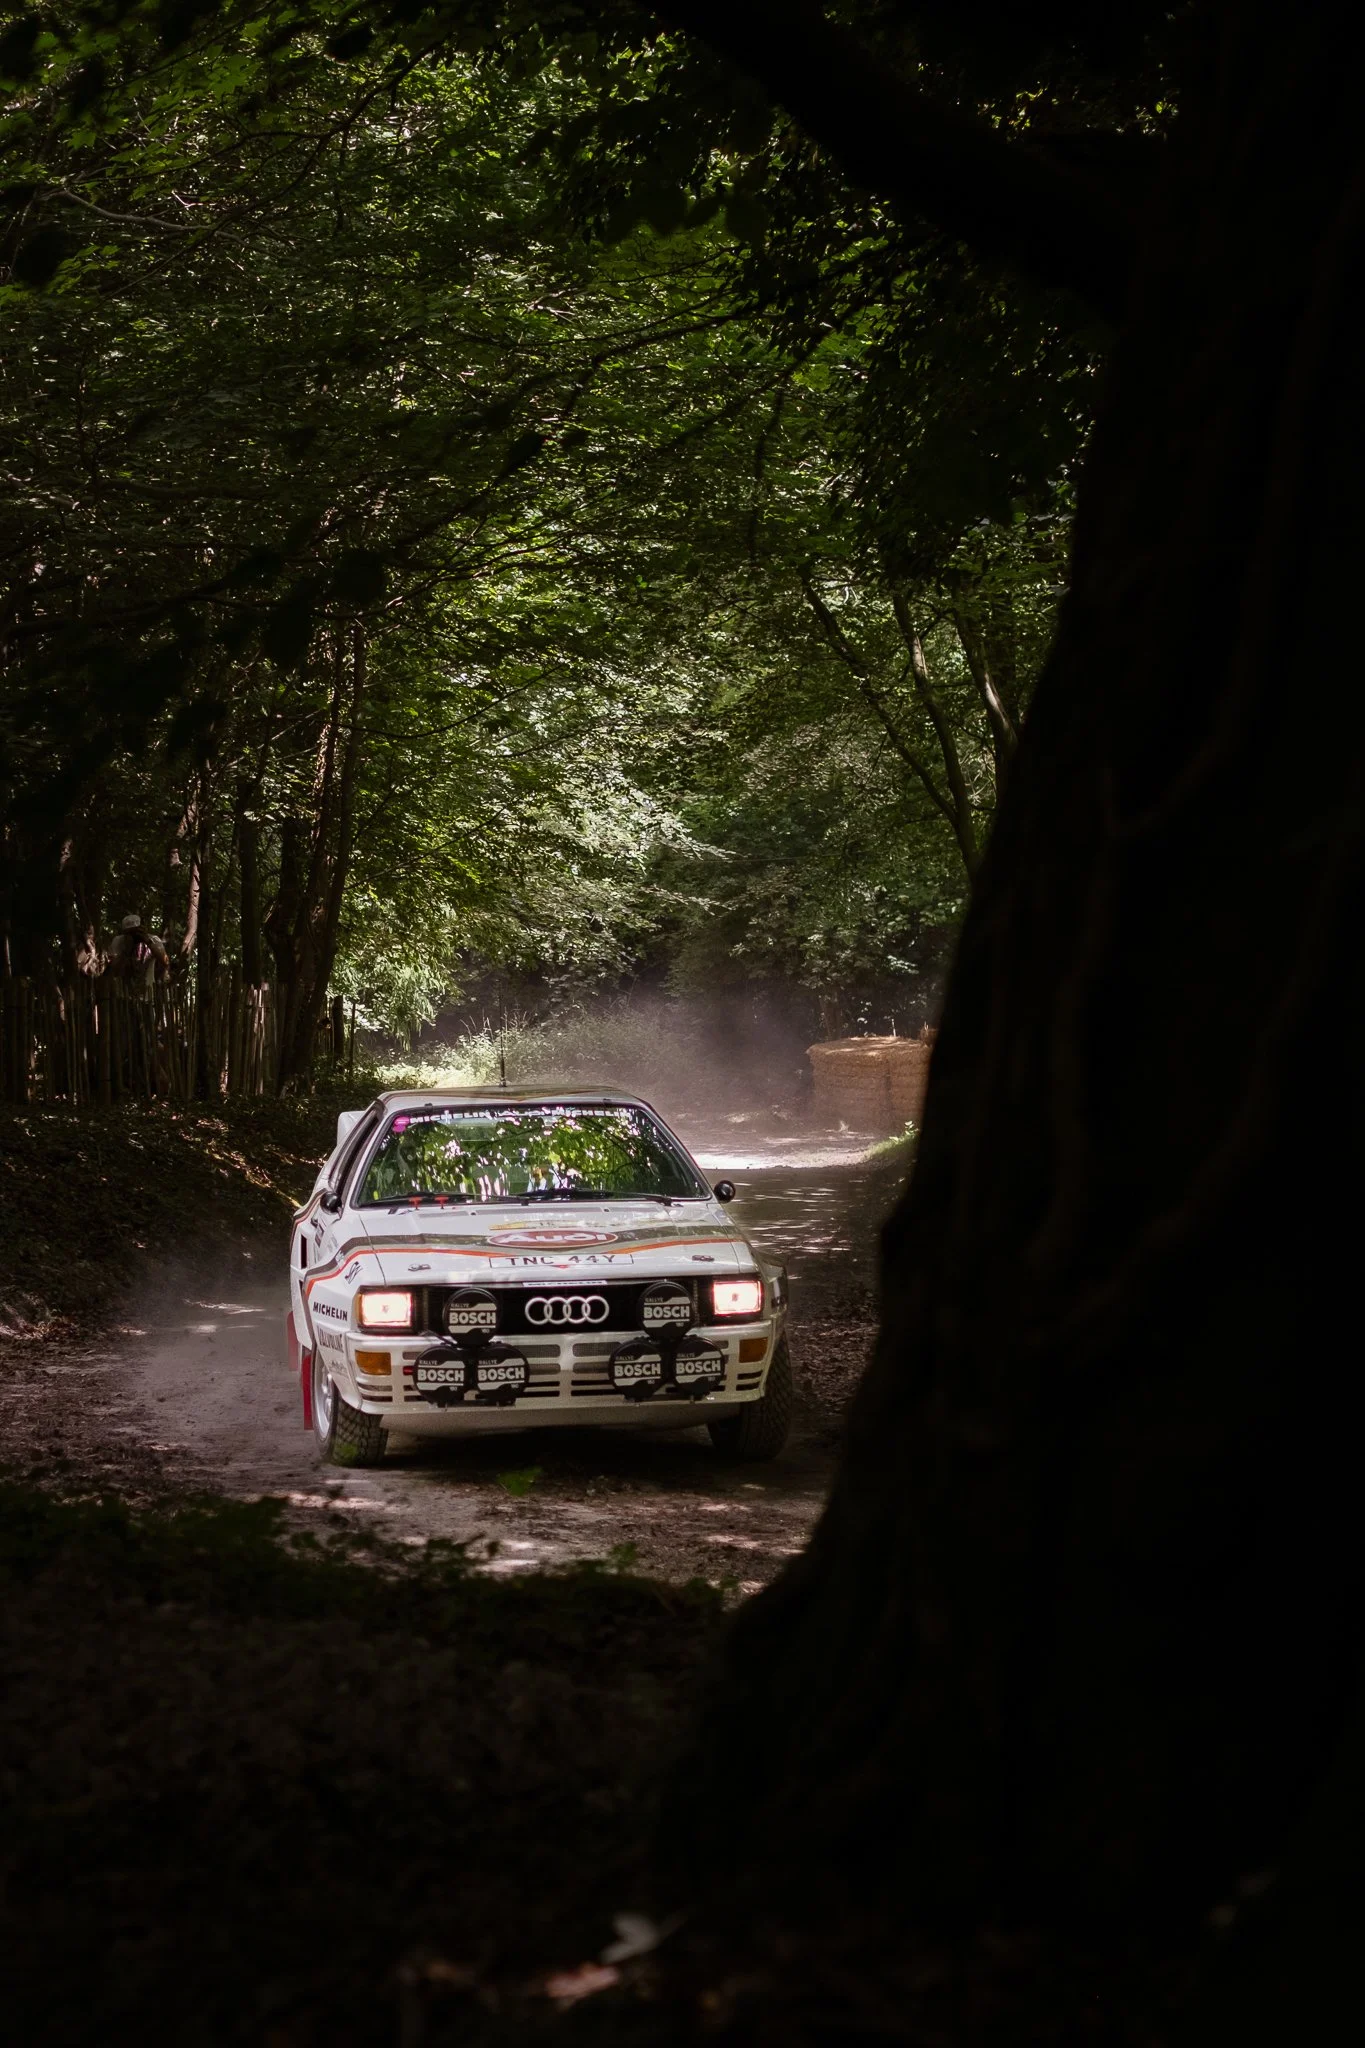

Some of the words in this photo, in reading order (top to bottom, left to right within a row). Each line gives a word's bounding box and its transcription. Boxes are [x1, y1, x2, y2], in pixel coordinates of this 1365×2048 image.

[410, 1111, 492, 1124] MICHELIN
[506, 1256, 554, 1266] TNC
[568, 1255, 616, 1264] 44Y
[313, 1302, 348, 1321] MICHELIN
[449, 1312, 497, 1324] BOSCH
[643, 1306, 690, 1319] BOSCH
[614, 1363, 661, 1377] BOSCH
[676, 1360, 721, 1374] BOSCH
[417, 1369, 465, 1382] BOSCH
[477, 1367, 525, 1381] BOSCH
